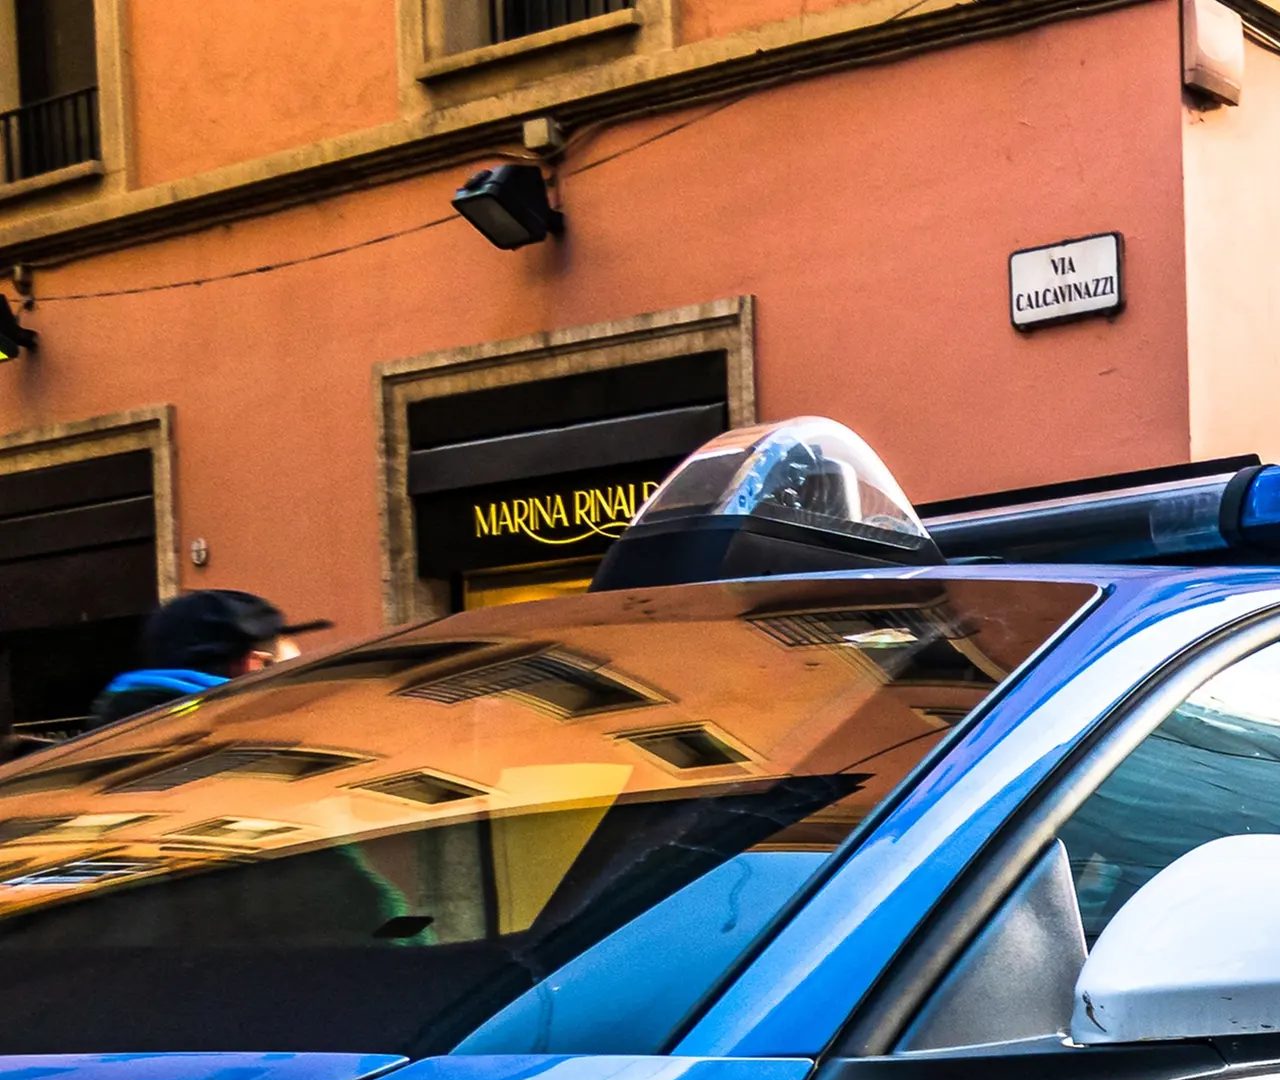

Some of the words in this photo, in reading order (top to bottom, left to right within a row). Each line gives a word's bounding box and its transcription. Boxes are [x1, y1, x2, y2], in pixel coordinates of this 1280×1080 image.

[1050, 256, 1076, 275] VIA
[1015, 275, 1115, 312] CALCAVINAZZI
[473, 493, 571, 544] MARINA
[574, 480, 661, 540] RINAL
